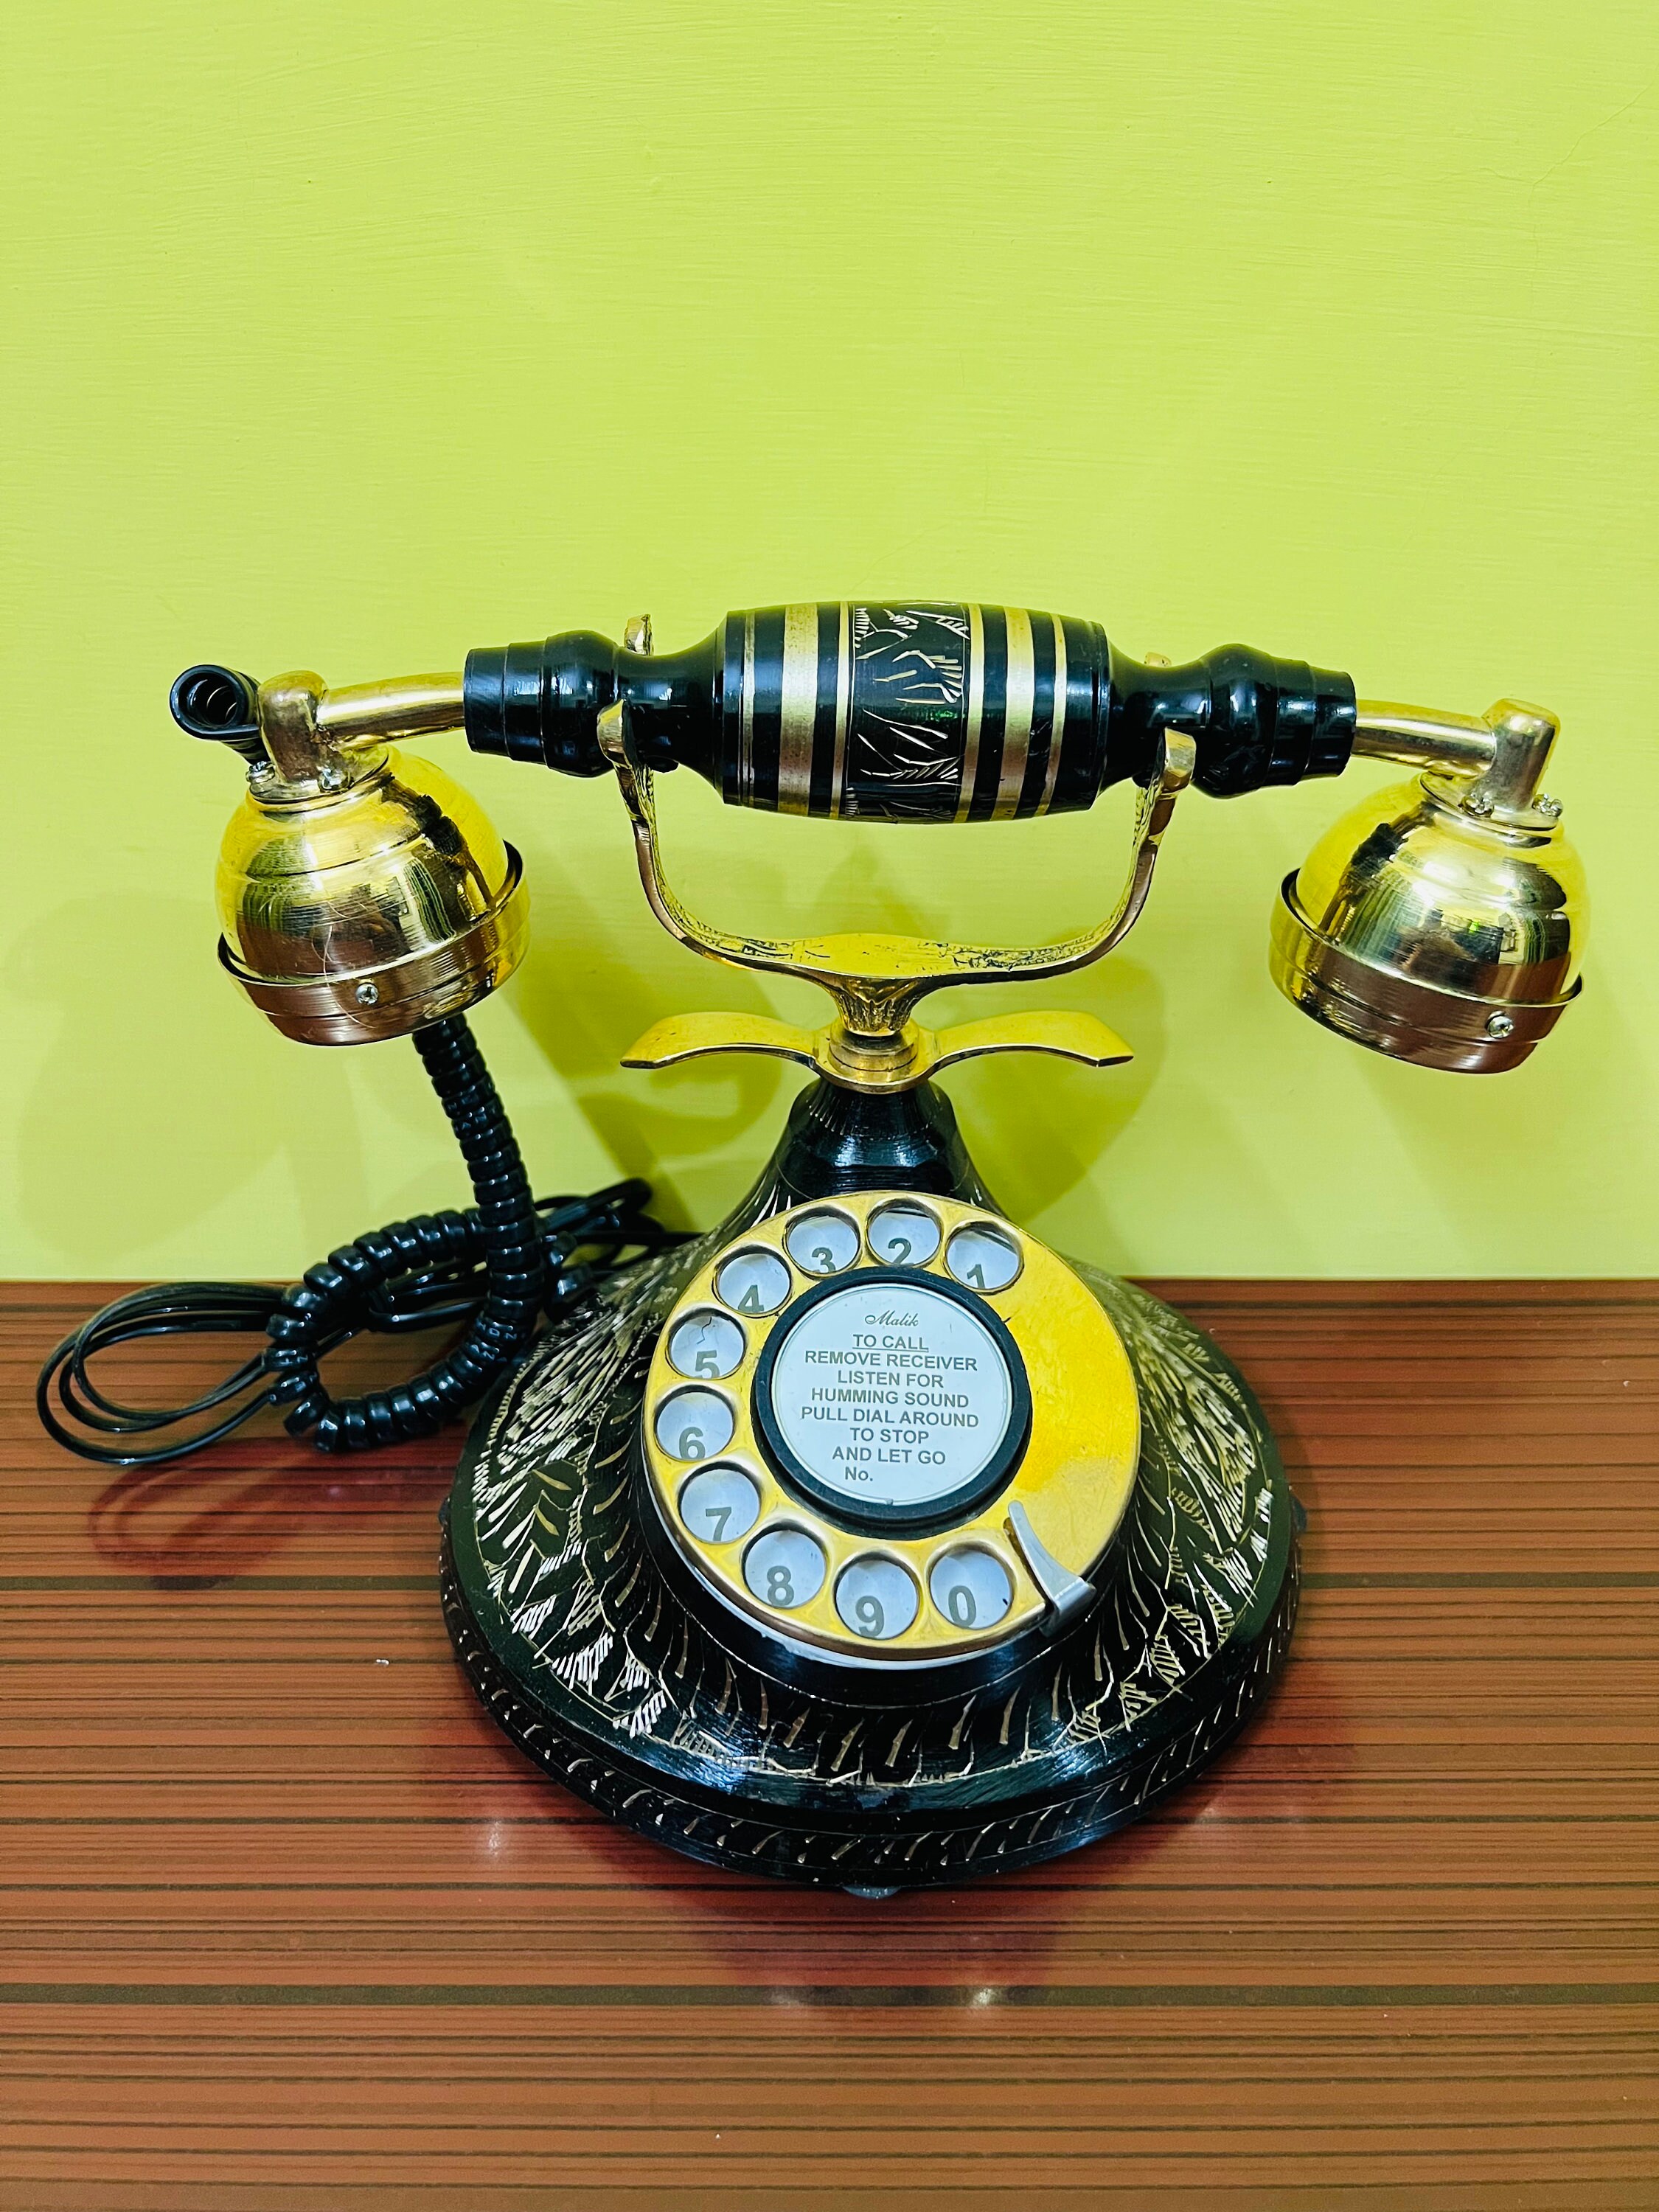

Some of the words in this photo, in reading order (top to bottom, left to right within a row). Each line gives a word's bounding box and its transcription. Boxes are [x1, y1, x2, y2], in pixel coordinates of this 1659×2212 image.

[810, 1248, 836, 1273] 3
[887, 1238, 913, 1266] 2
[967, 1265, 987, 1290] 1
[738, 1285, 764, 1313] 4
[864, 1310, 919, 1326] Malik
[853, 1334, 877, 1349] TO
[883, 1335, 929, 1350] CALL
[695, 1351, 720, 1379] 5
[805, 1351, 880, 1366] REMOVE
[886, 1353, 977, 1371] RECEIVER
[838, 1370, 900, 1386] LISTEN
[906, 1374, 944, 1388] FOR
[811, 1388, 898, 1404] HUMMING
[905, 1391, 969, 1408] SOUND
[801, 1407, 847, 1421] PULL
[853, 1408, 894, 1423] DIAL
[900, 1411, 979, 1427] AROUND
[678, 1427, 706, 1459] 6
[850, 1427, 874, 1441] TO
[880, 1429, 929, 1444] STOP
[832, 1447, 872, 1461] AND
[877, 1448, 912, 1463] LET
[918, 1450, 946, 1465] GO
[844, 1467, 873, 1481] No.
[706, 1507, 732, 1540] 7
[766, 1565, 795, 1605] 8
[855, 1597, 885, 1638] 9
[948, 1586, 977, 1627] 0
